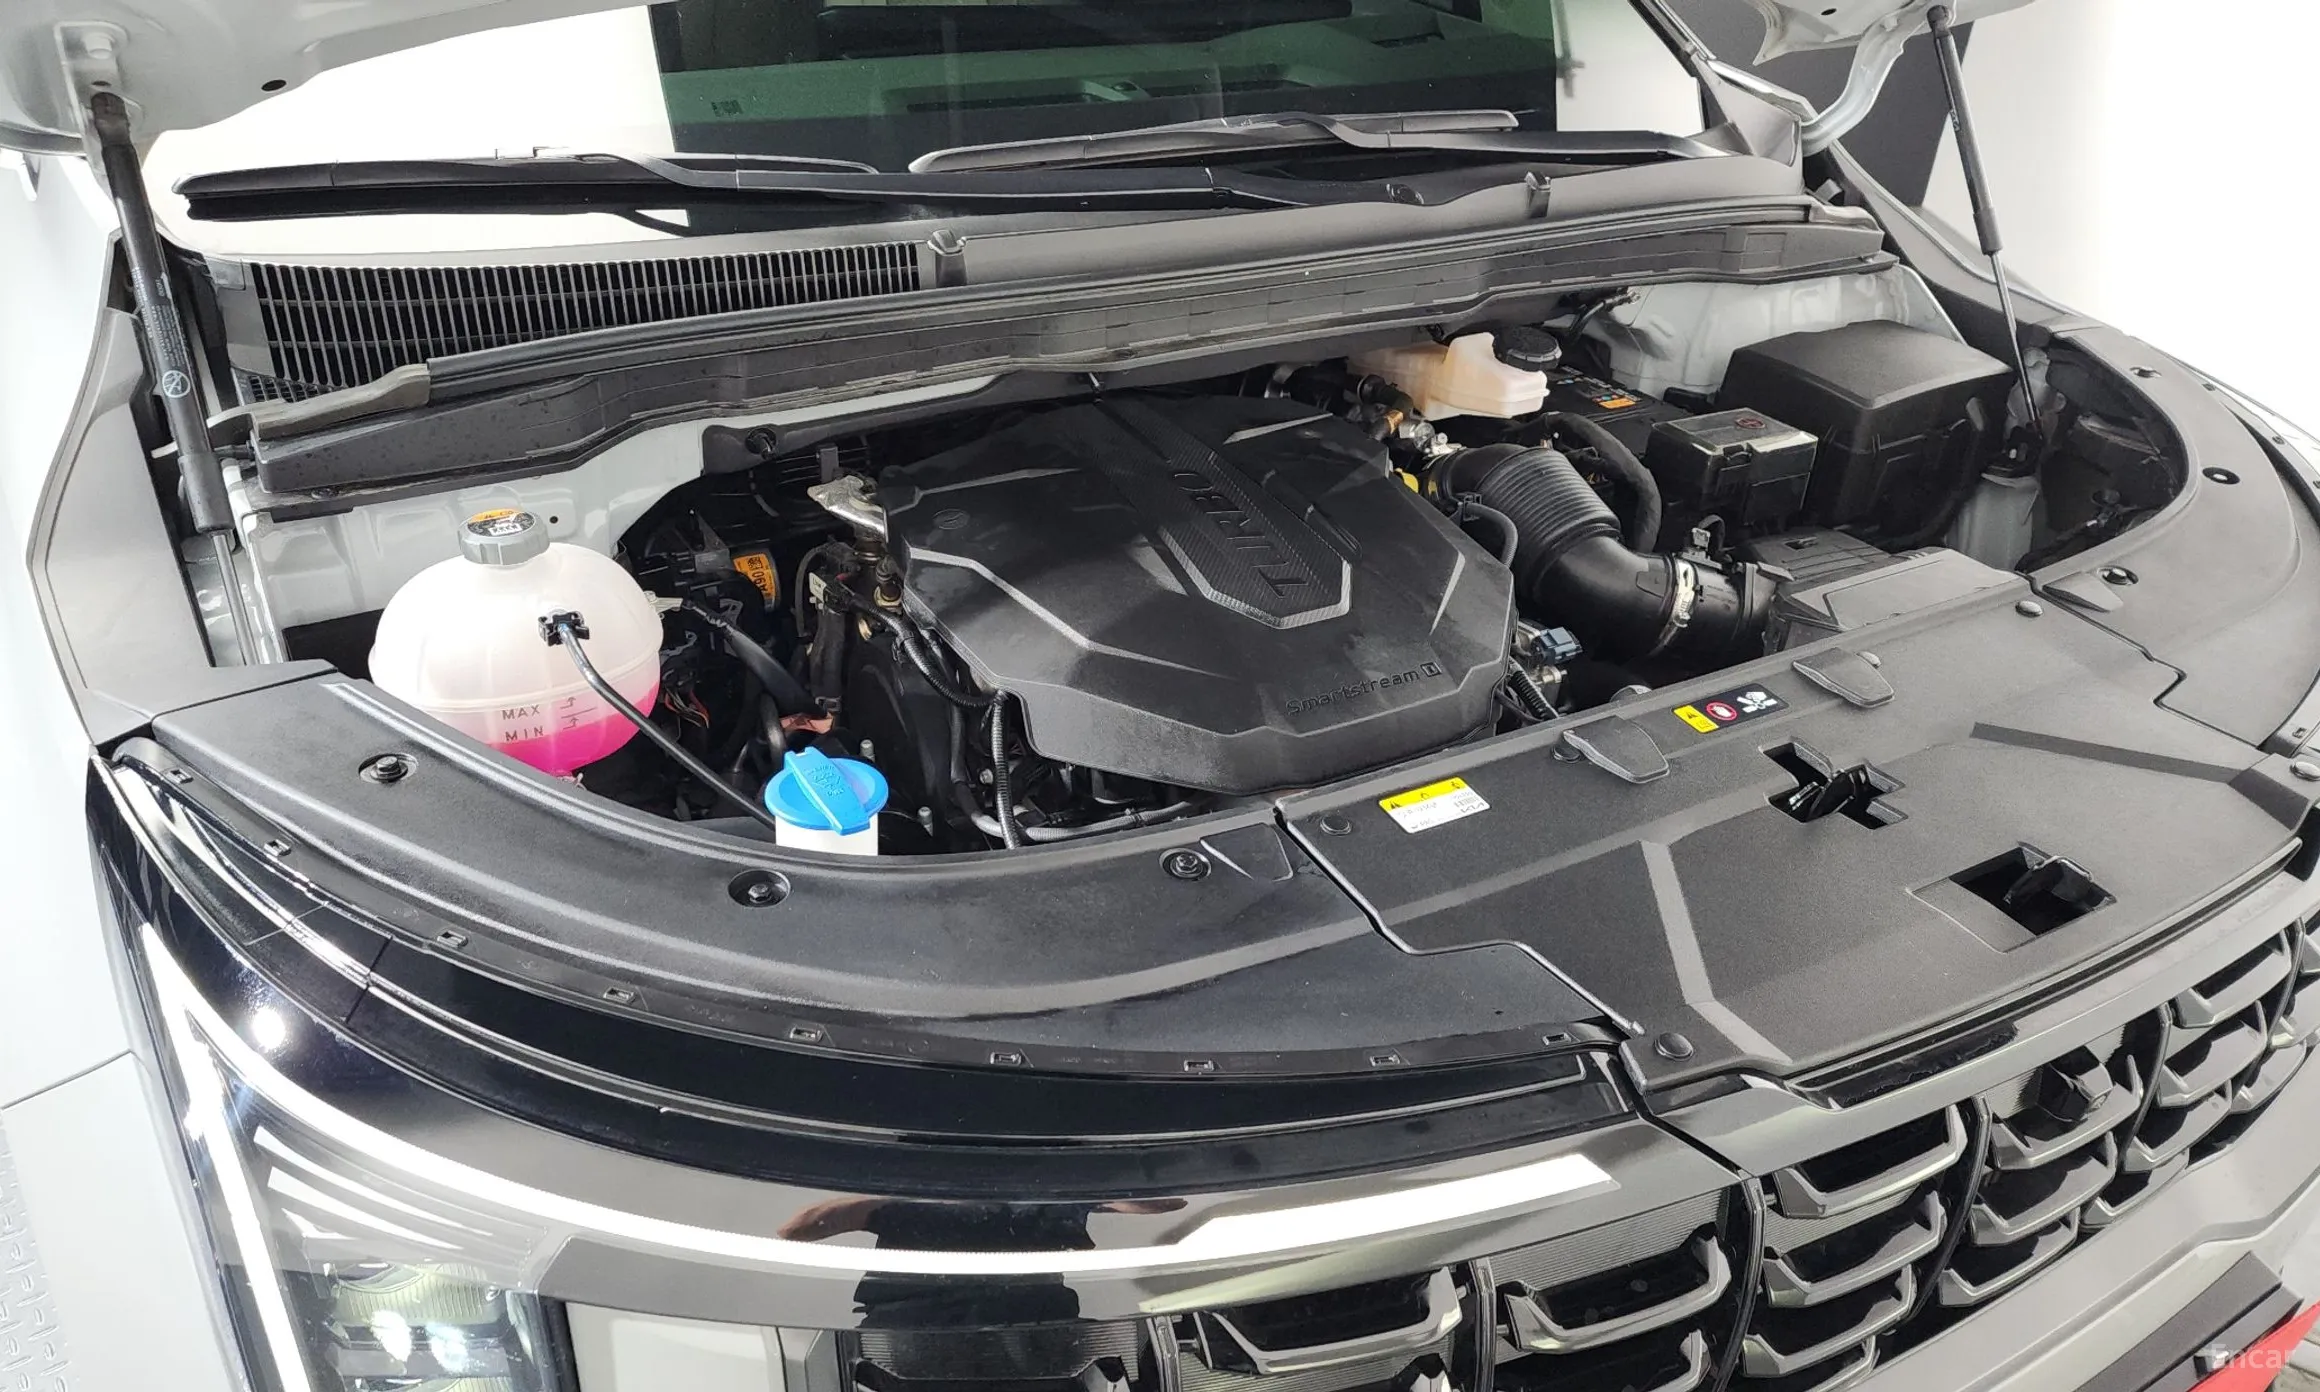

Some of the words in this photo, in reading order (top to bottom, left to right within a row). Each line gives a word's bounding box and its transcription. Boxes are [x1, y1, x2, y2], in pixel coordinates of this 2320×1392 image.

[1172, 471, 1309, 599] TURBO
[1286, 669, 1420, 715] Smartstream
[502, 704, 540, 720] MAX
[505, 726, 544, 742] MIN
